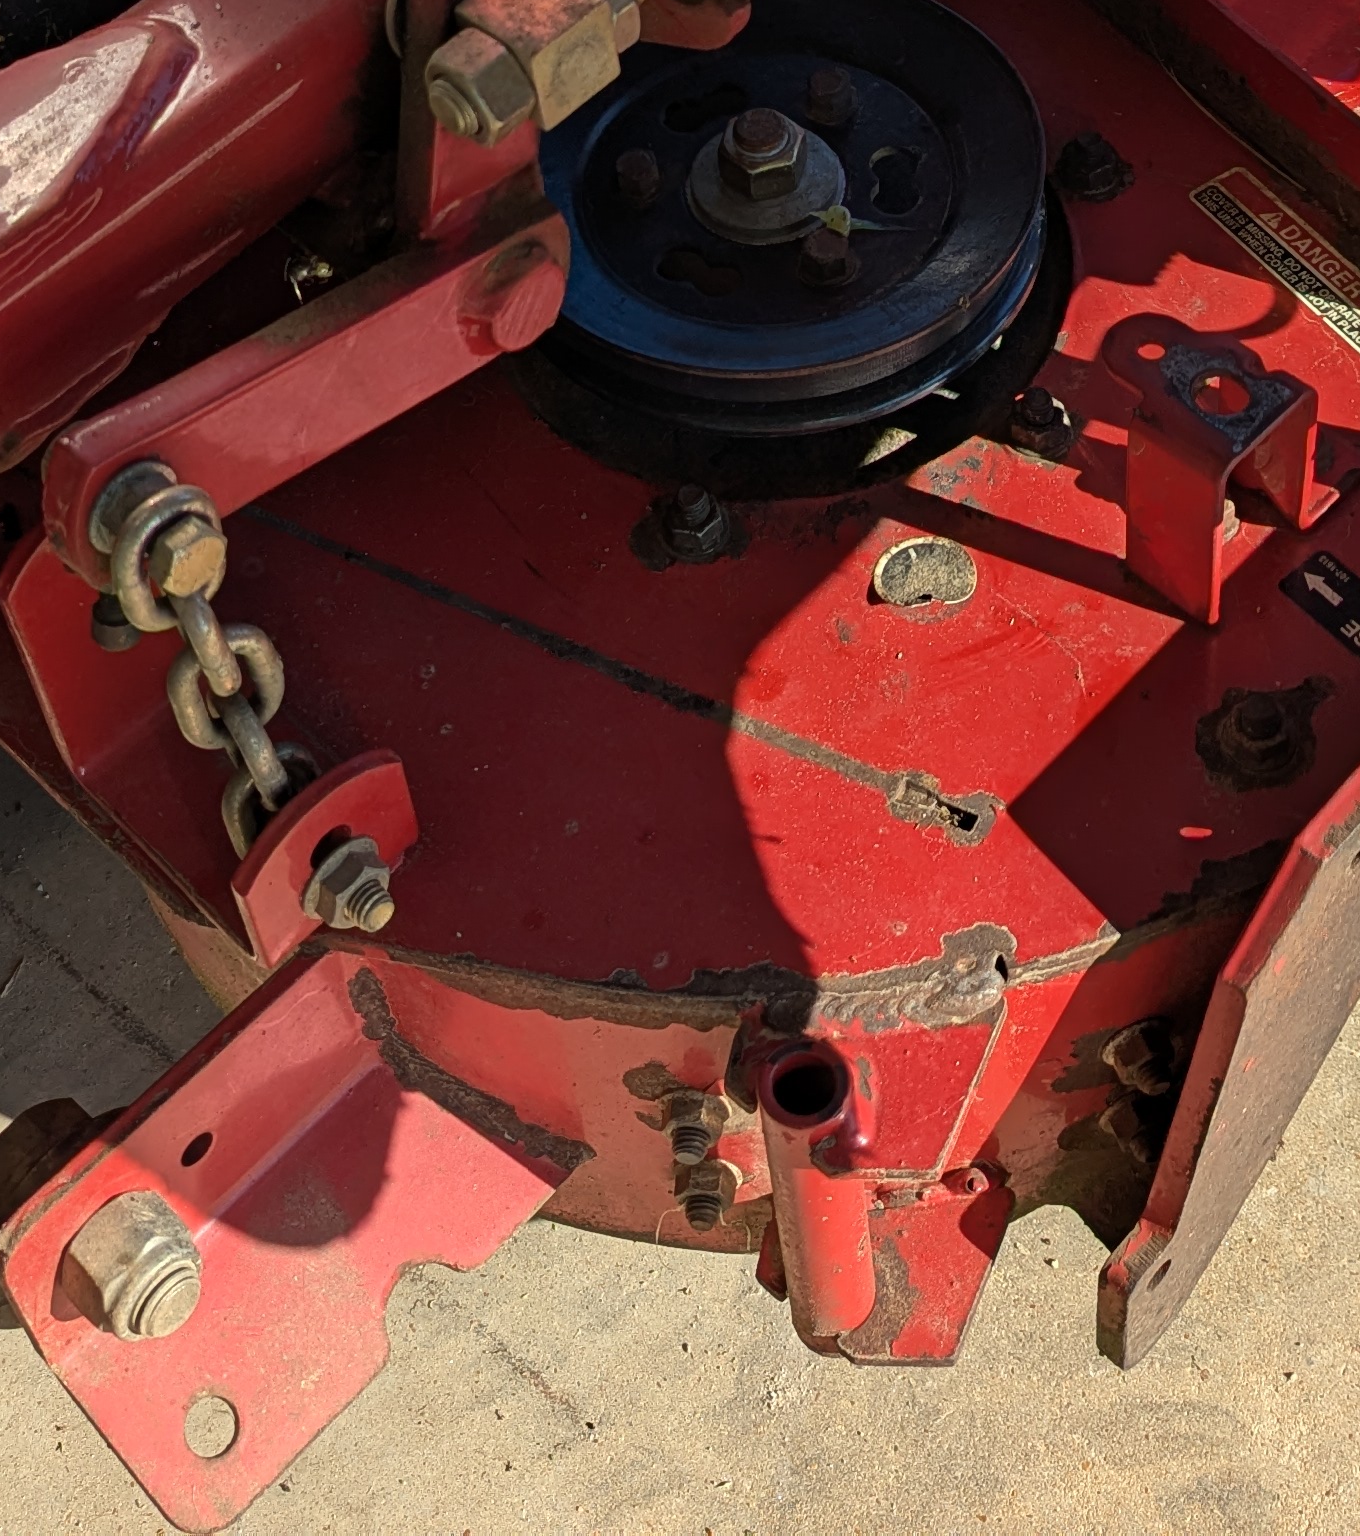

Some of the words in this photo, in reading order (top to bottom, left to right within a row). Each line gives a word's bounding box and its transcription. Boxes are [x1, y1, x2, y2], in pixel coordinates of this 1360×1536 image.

[1196, 193, 1219, 212] THIS
[1215, 210, 1240, 230] UNIT
[1236, 229, 1268, 255] WHEN
[1262, 252, 1299, 283] COVER
[1294, 280, 1309, 292] IS
[1304, 290, 1331, 312] NOT
[1325, 309, 1342, 322] IN
[1204, 187, 1239, 215] COVER
[1234, 214, 1249, 225] IS
[1282, 256, 1302, 272] DO
[1297, 270, 1322, 290] NOT
